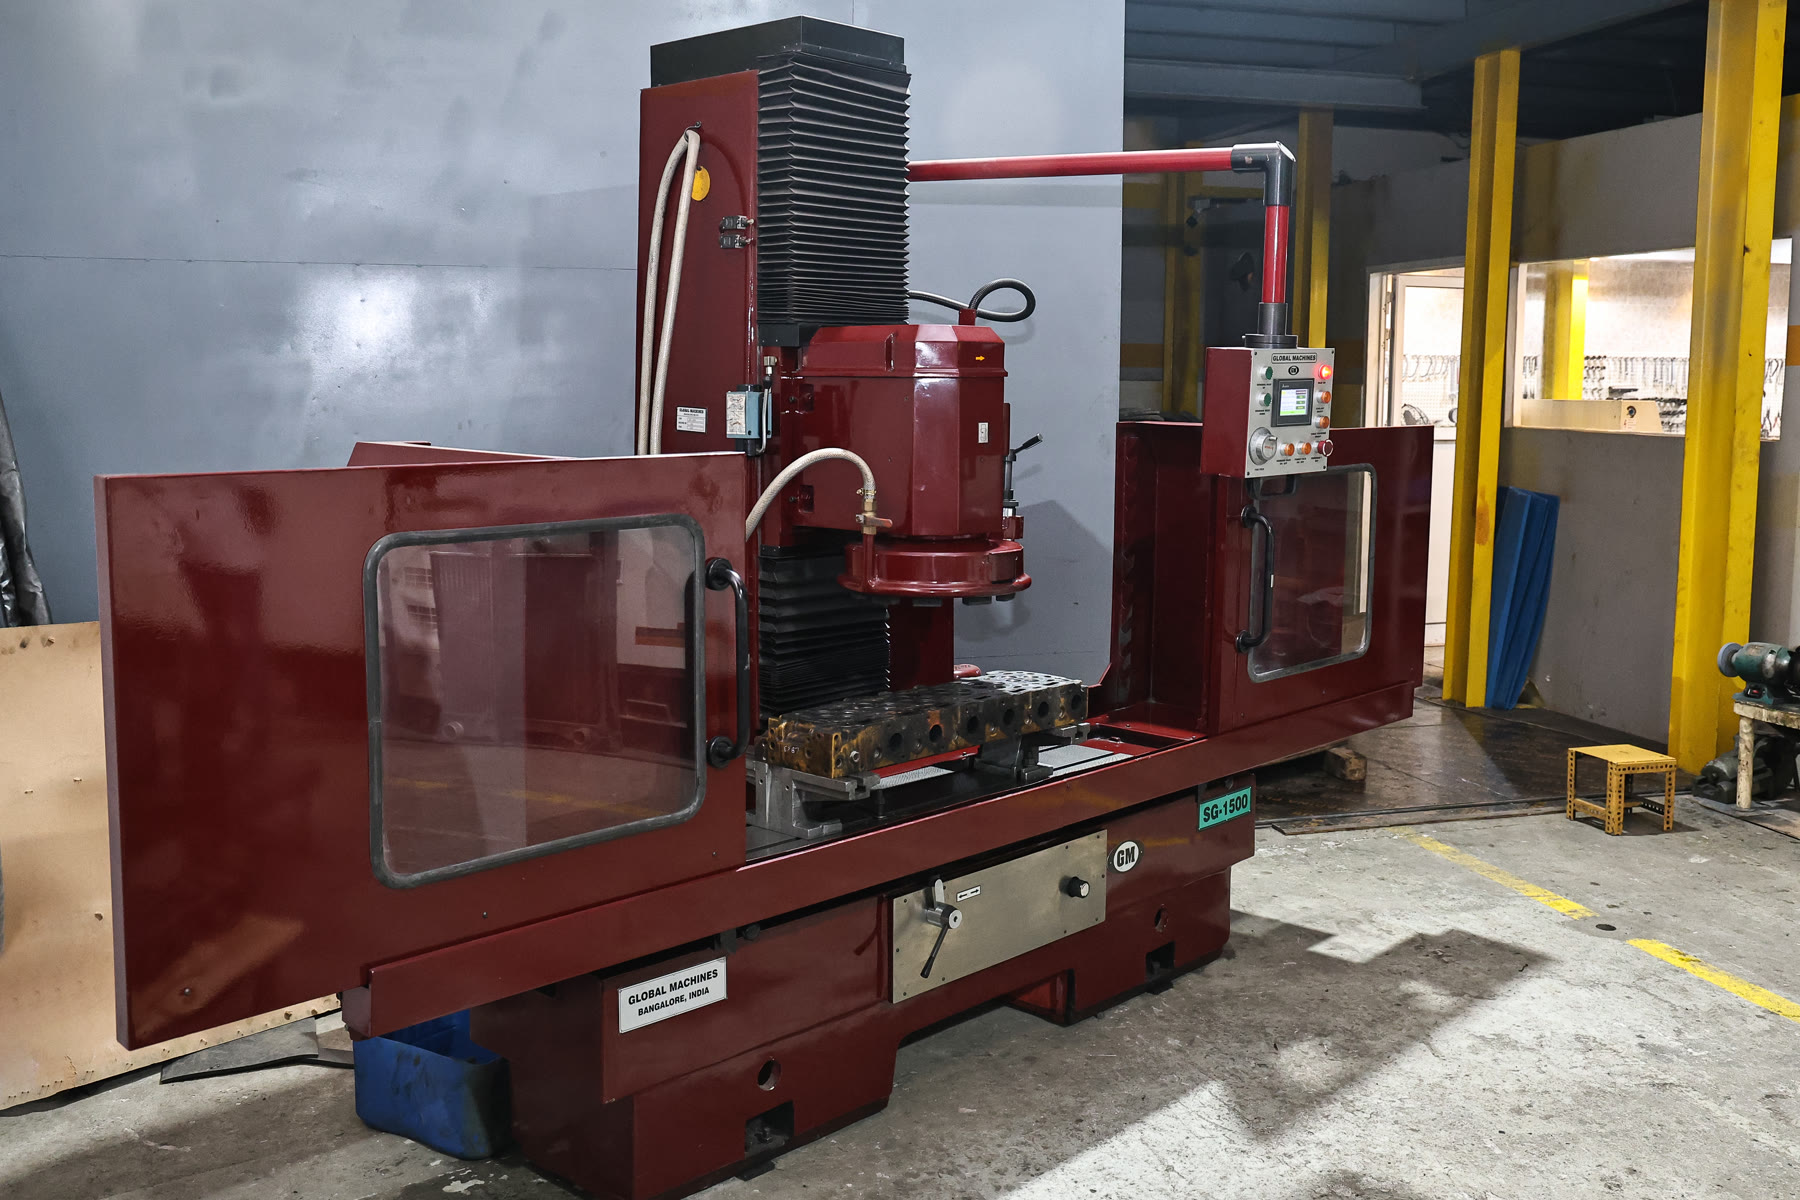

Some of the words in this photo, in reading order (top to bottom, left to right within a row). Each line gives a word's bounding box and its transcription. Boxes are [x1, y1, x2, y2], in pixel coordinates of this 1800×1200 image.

[1203, 793, 1248, 822] SG-1500
[1116, 846, 1136, 868] GM
[628, 986, 667, 1005] GLOBAL
[669, 969, 718, 992] MACHINES
[638, 995, 687, 1016] BANGALORE,
[689, 987, 710, 999] INDIA
